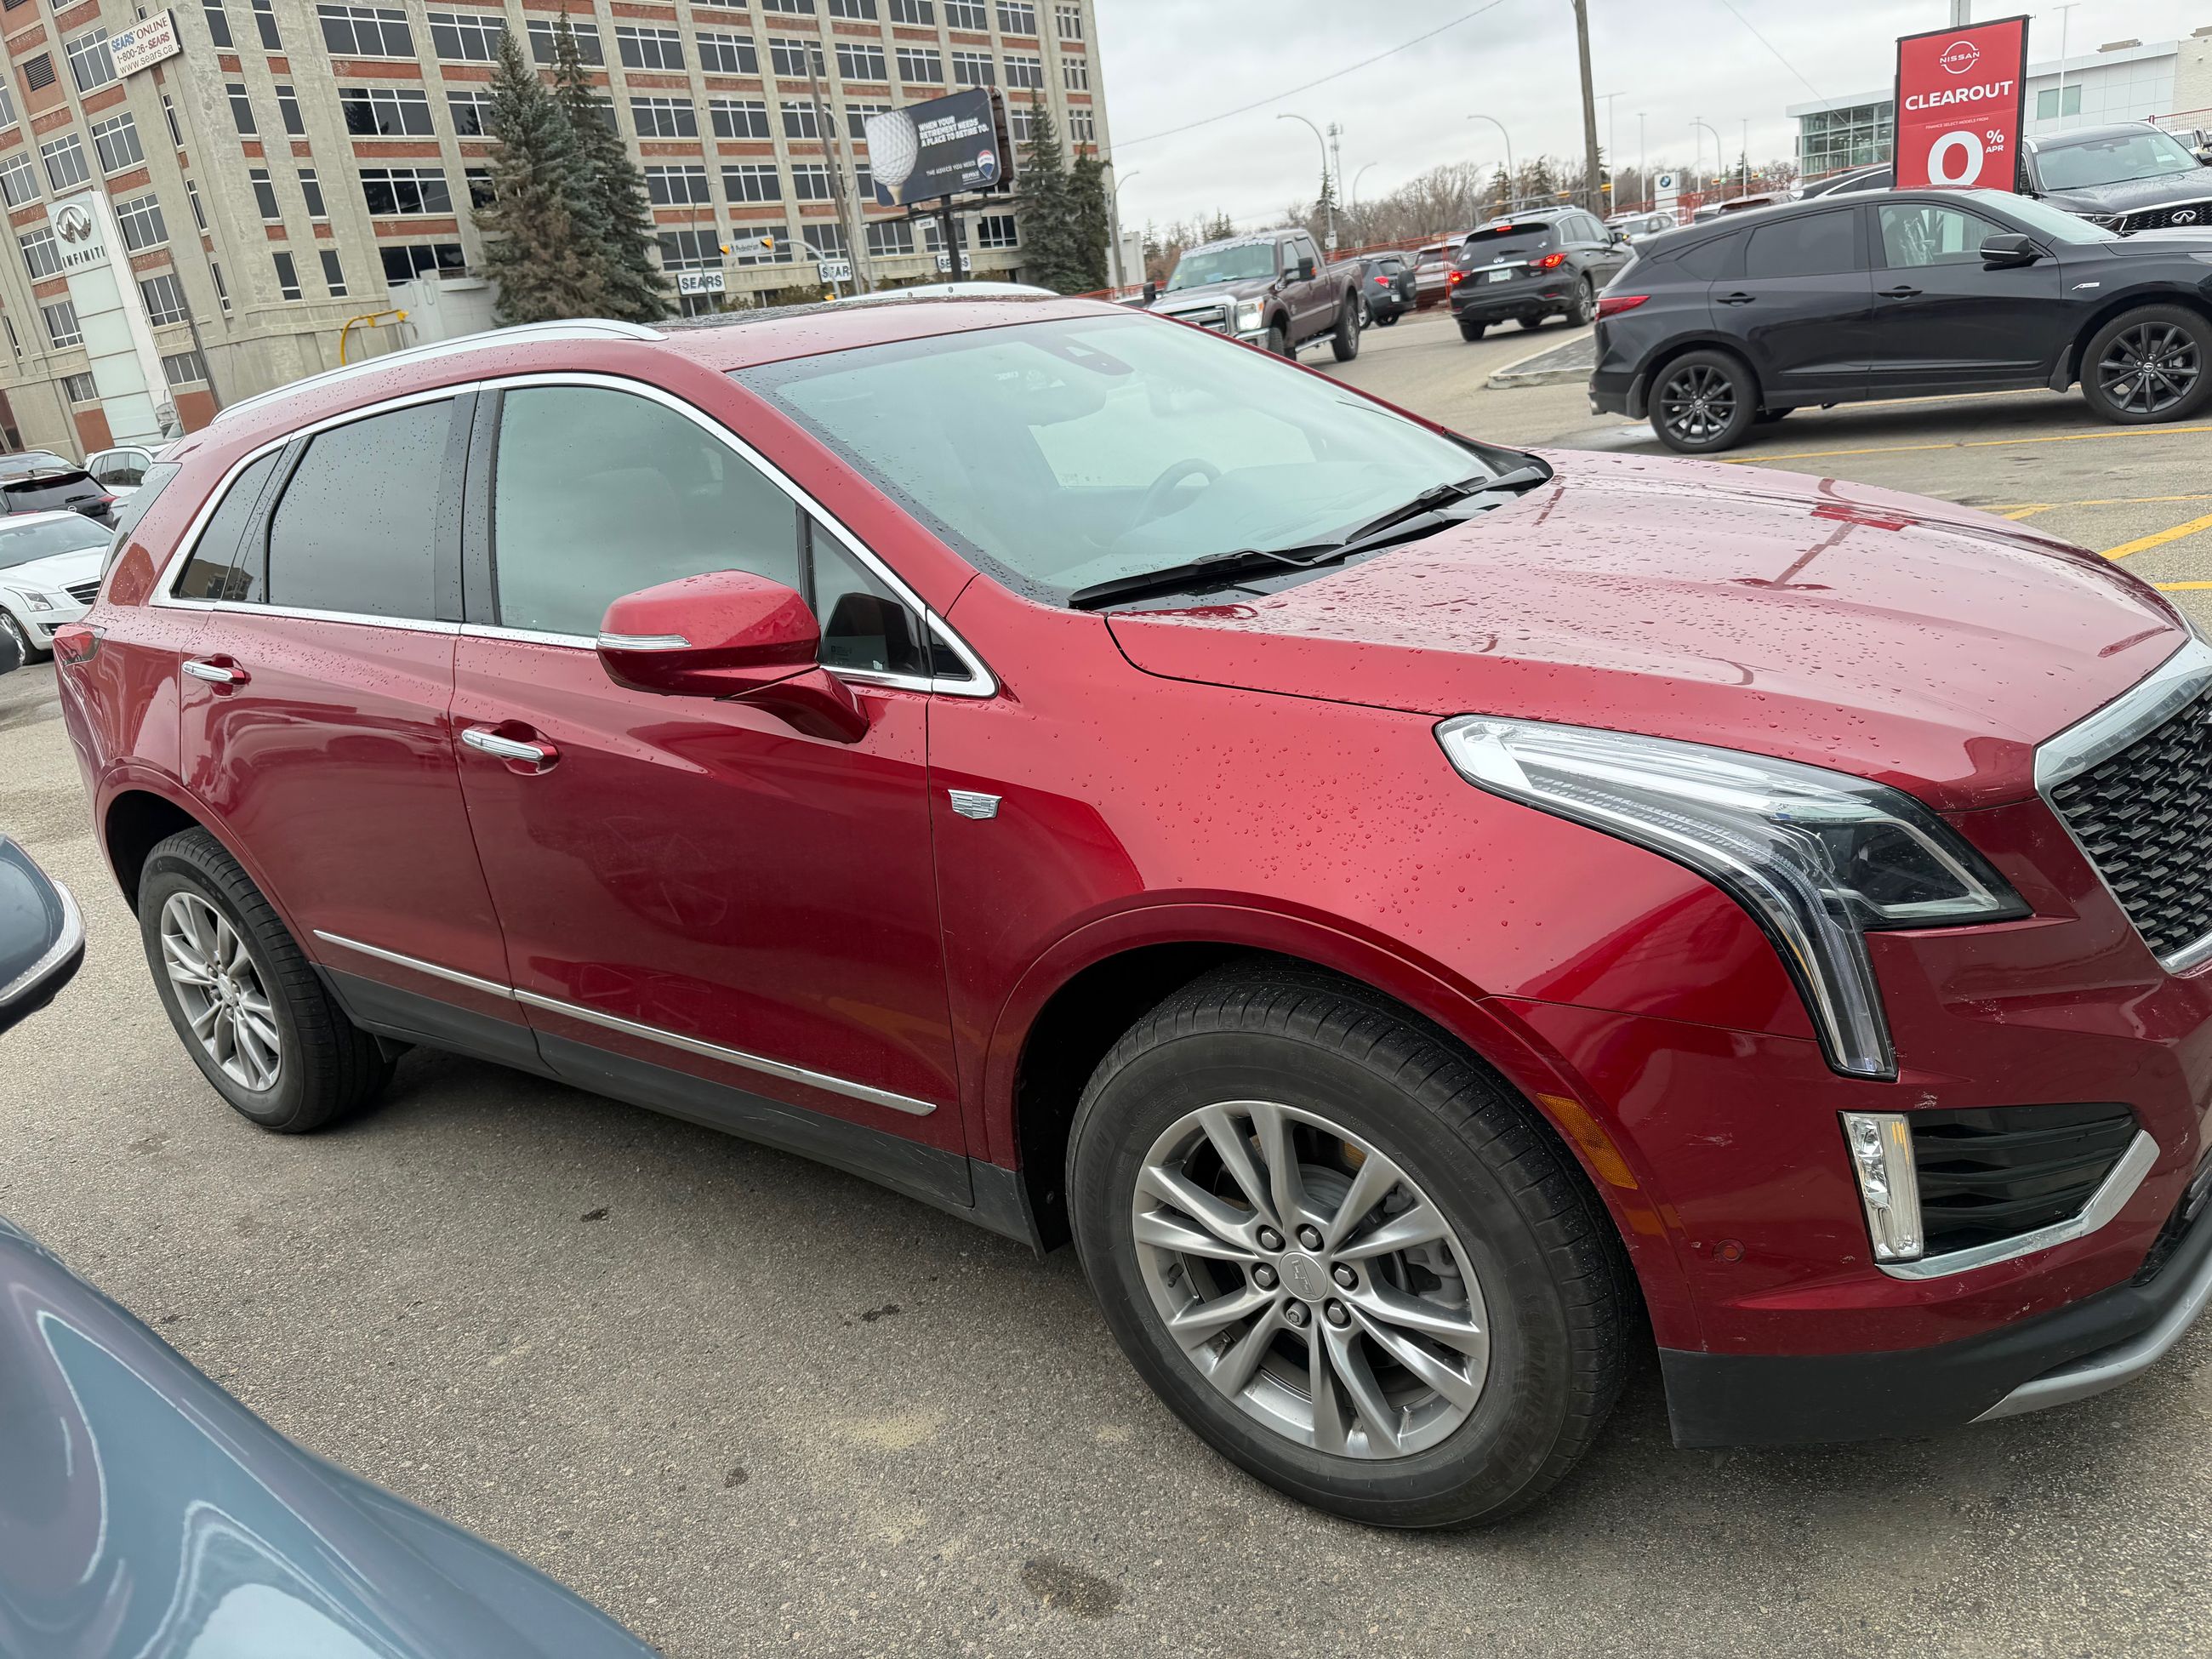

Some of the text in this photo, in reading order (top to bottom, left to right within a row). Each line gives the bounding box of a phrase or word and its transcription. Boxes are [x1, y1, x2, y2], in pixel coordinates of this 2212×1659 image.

[136, 17, 168, 39] ONLINE
[119, 44, 174, 74] www.sears.ca
[1940, 51, 1980, 64] NISSAN
[1905, 80, 2014, 111] CLEAROUT
[918, 116, 955, 132] WHEN YOUR
[920, 117, 978, 140] RETIREMENT NEEDS
[926, 134, 947, 146] PLACE
[946, 130, 955, 142] TO
[955, 125, 978, 139] RETIRE
[1985, 145, 2004, 154] APR
[61, 245, 105, 268] INFINITI
[681, 274, 722, 290] SEARS
